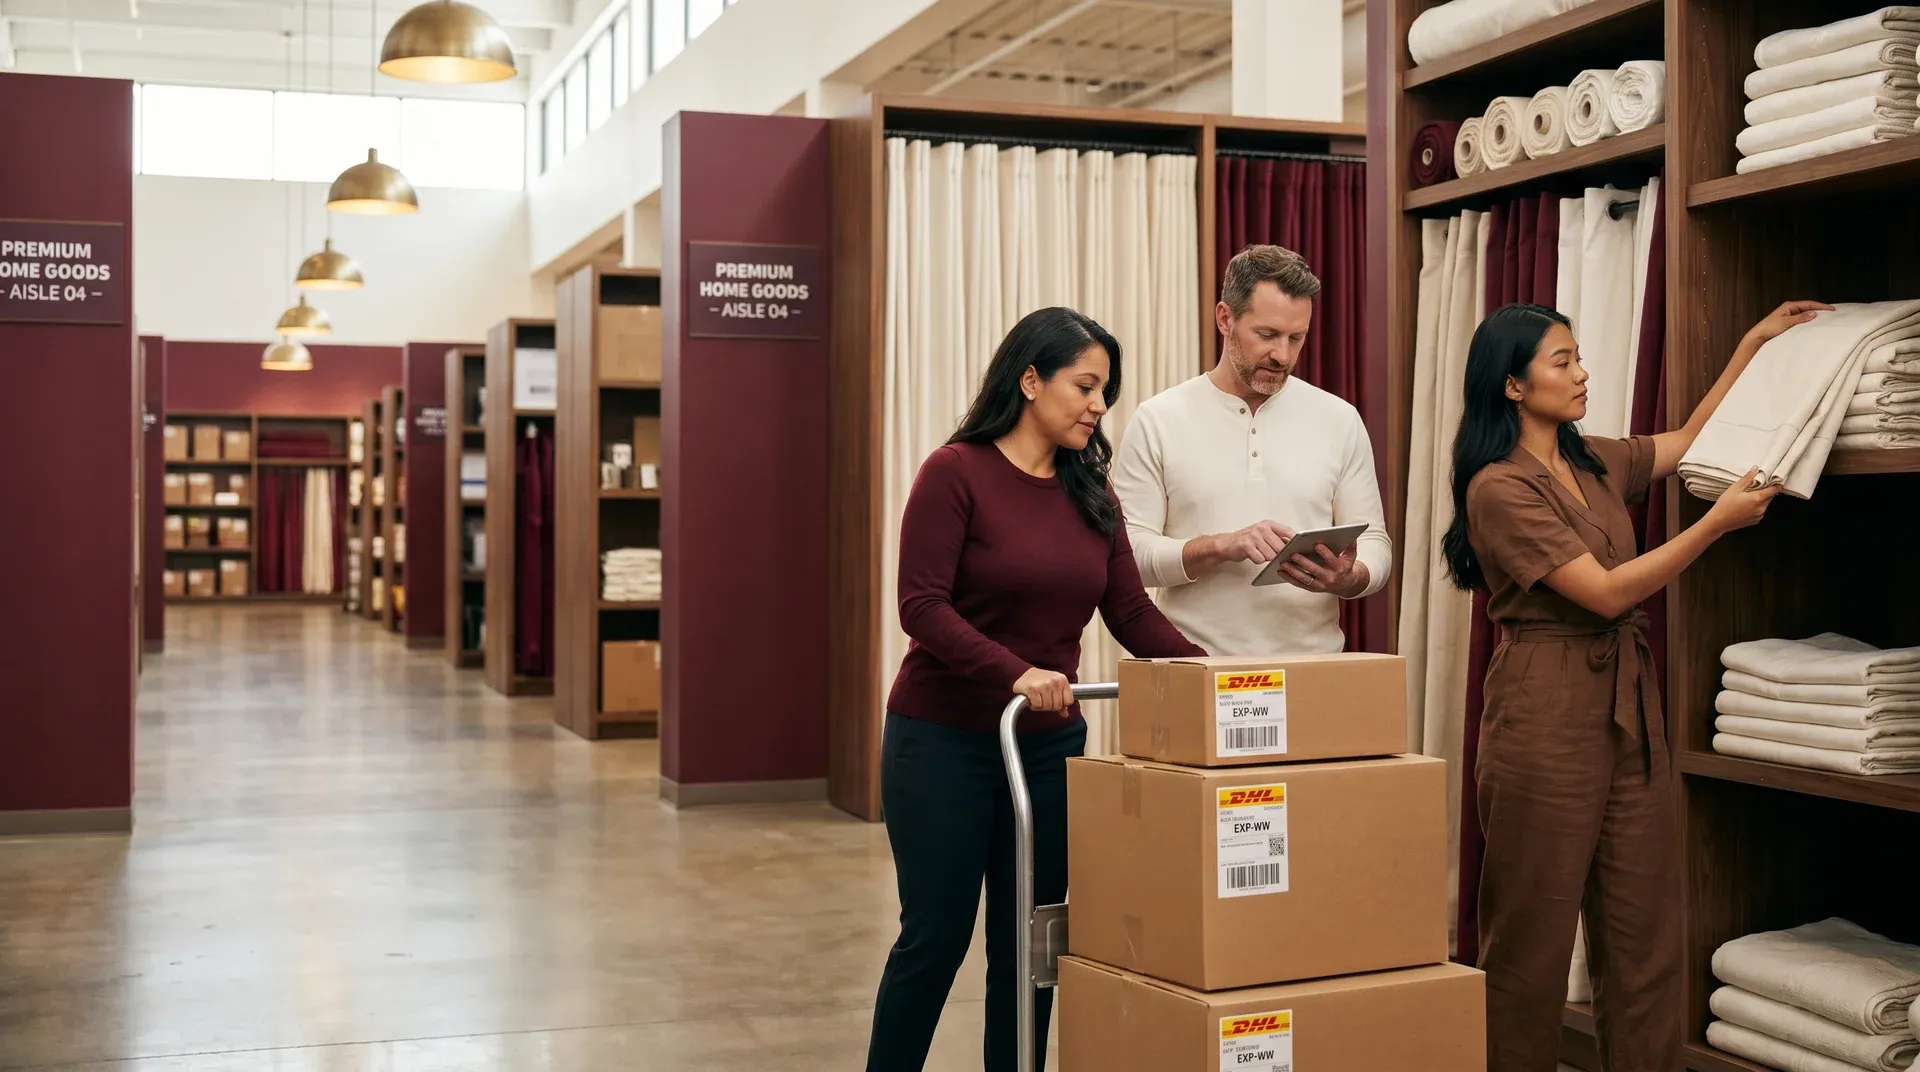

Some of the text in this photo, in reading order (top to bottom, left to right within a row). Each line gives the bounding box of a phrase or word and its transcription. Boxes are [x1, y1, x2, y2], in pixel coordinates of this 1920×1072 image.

[2, 240, 91, 259] PREMIUM
[0, 261, 111, 281] OME GOODS
[715, 262, 794, 280] PREMIUM
[9, 283, 60, 301] AISLE
[64, 285, 87, 301] 04
[700, 281, 809, 300] HOME GOODS
[721, 302, 766, 319] AISLE
[768, 304, 789, 319] 04
[1228, 674, 1274, 689] DHL
[1233, 706, 1269, 718] EXP-WW
[1229, 789, 1275, 805] DHL
[1234, 821, 1271, 834] EXP-WW
[1232, 1016, 1281, 1035] DHL
[1237, 1050, 1275, 1064] EXP-WW
